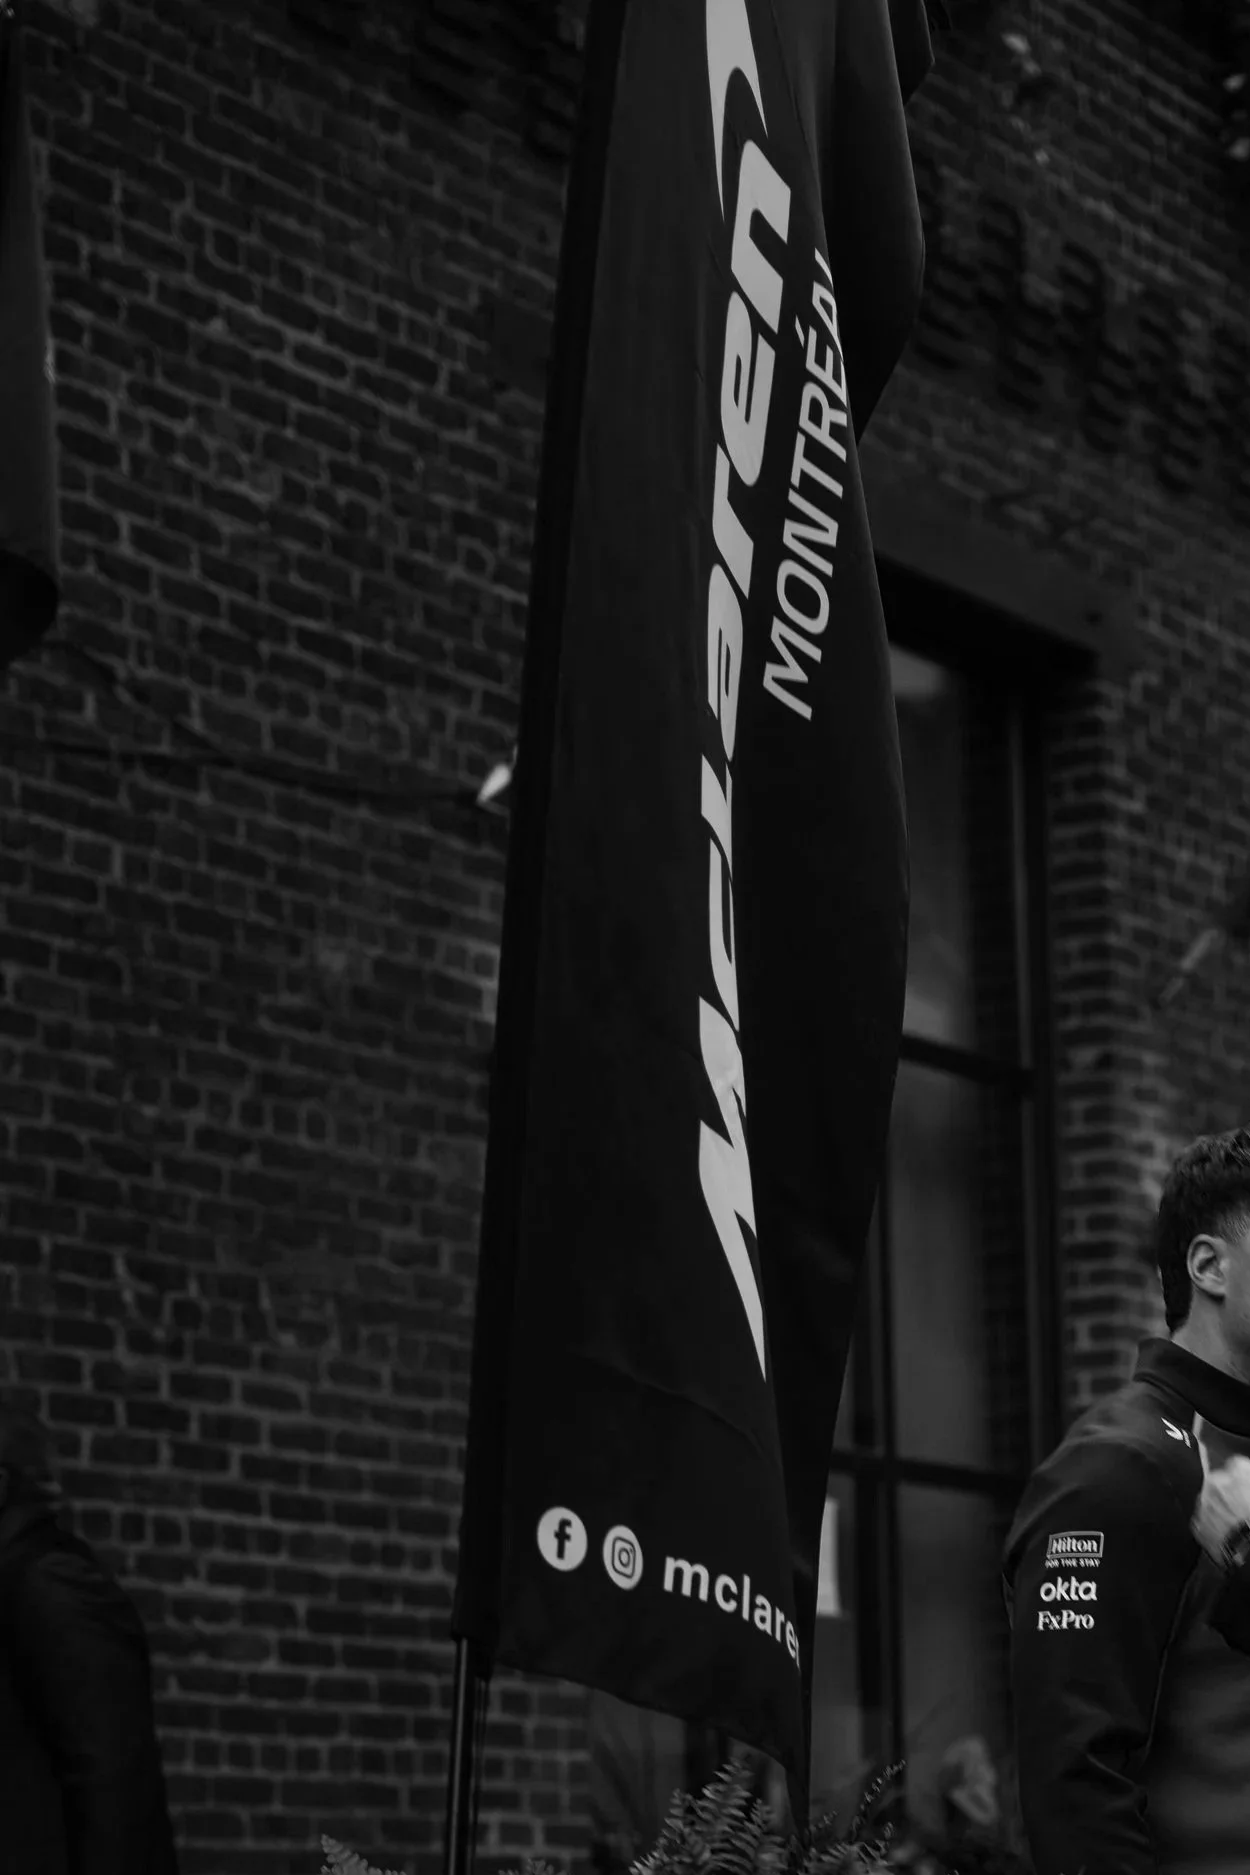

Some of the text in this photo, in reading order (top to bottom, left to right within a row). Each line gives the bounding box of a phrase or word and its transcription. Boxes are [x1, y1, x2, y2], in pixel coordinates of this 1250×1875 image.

[1051, 1537, 1098, 1554] Hilton
[1039, 1575, 1098, 1602] okta
[663, 1555, 801, 1673] mclare
[1036, 1609, 1096, 1631] FxPro
